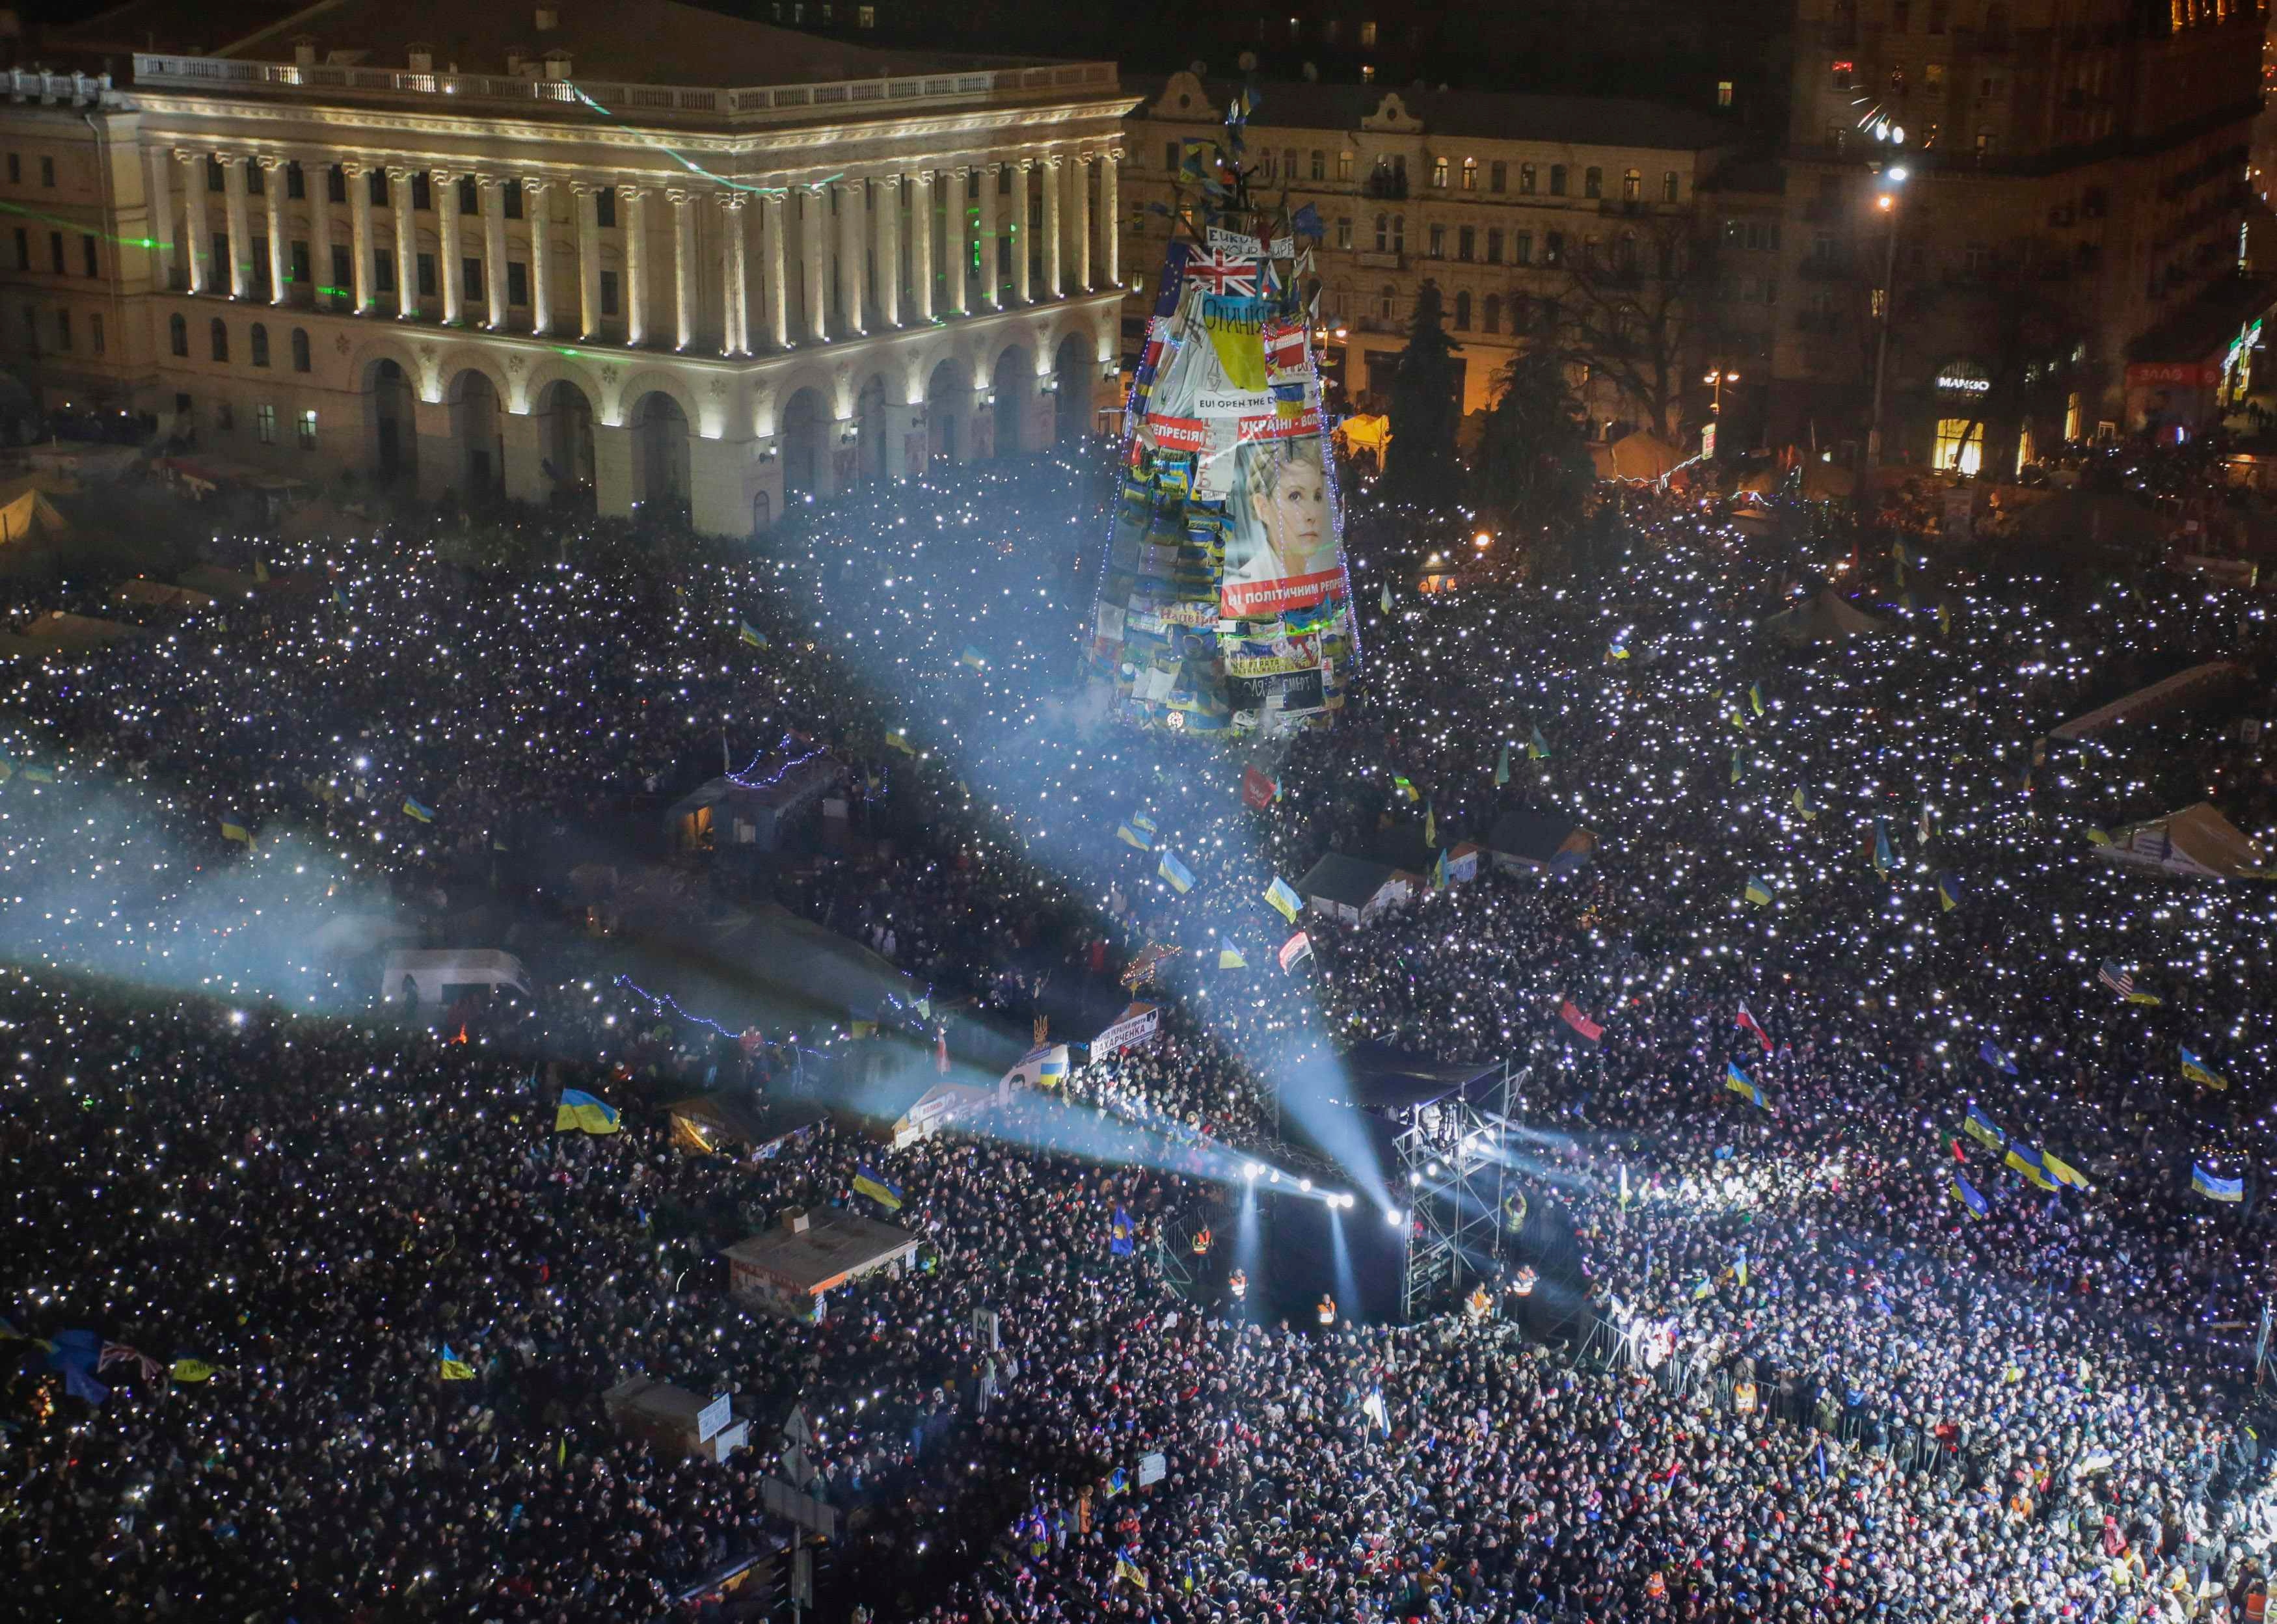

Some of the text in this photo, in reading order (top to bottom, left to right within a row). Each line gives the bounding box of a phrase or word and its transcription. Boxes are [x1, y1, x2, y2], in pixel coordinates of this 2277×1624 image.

[1939, 377, 1989, 390] MANGO
[1218, 399, 1245, 408] OPEN
[1247, 397, 1265, 406] THE
[1301, 412, 1321, 427] ВОЛ
[1151, 423, 1204, 443] ЕПРЕСІЯ
[1245, 585, 1319, 604] ПОЛІТИЧНИМ
[1321, 577, 1343, 593] РЕПРЕ
[1093, 1024, 1145, 1054] ЗАХАРЧЕНКА
